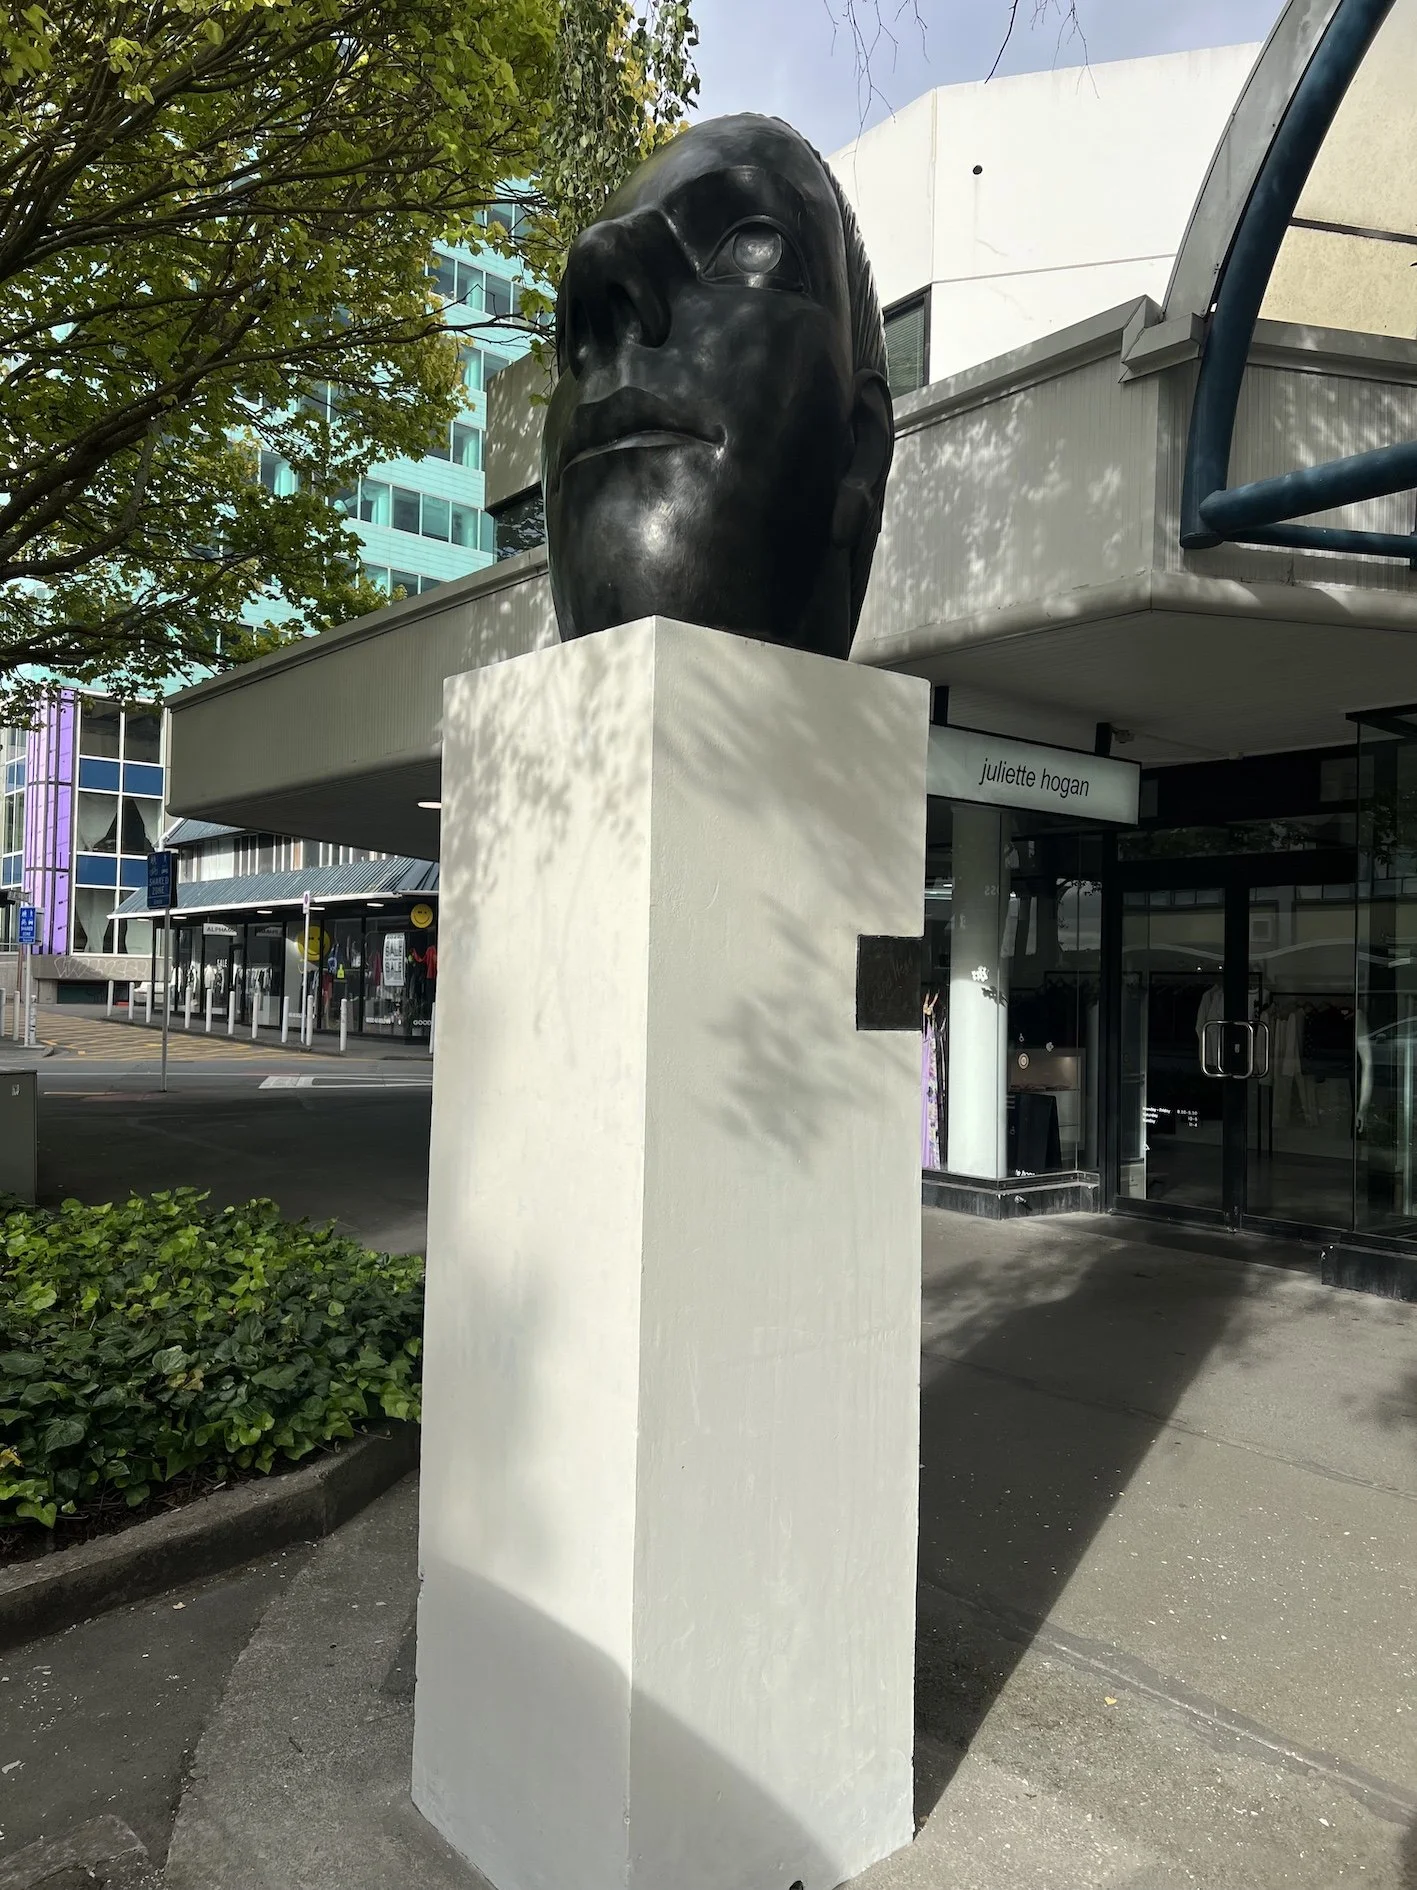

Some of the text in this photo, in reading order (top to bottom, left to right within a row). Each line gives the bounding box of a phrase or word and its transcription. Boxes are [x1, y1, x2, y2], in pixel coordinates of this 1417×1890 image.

[979, 757, 1090, 799] juliette hogan
[149, 876, 170, 887] SHARED
[151, 886, 165, 896] ZONE
[384, 943, 402, 957] SALE
[216, 958, 229, 968] SALE
[384, 961, 403, 974] SALE
